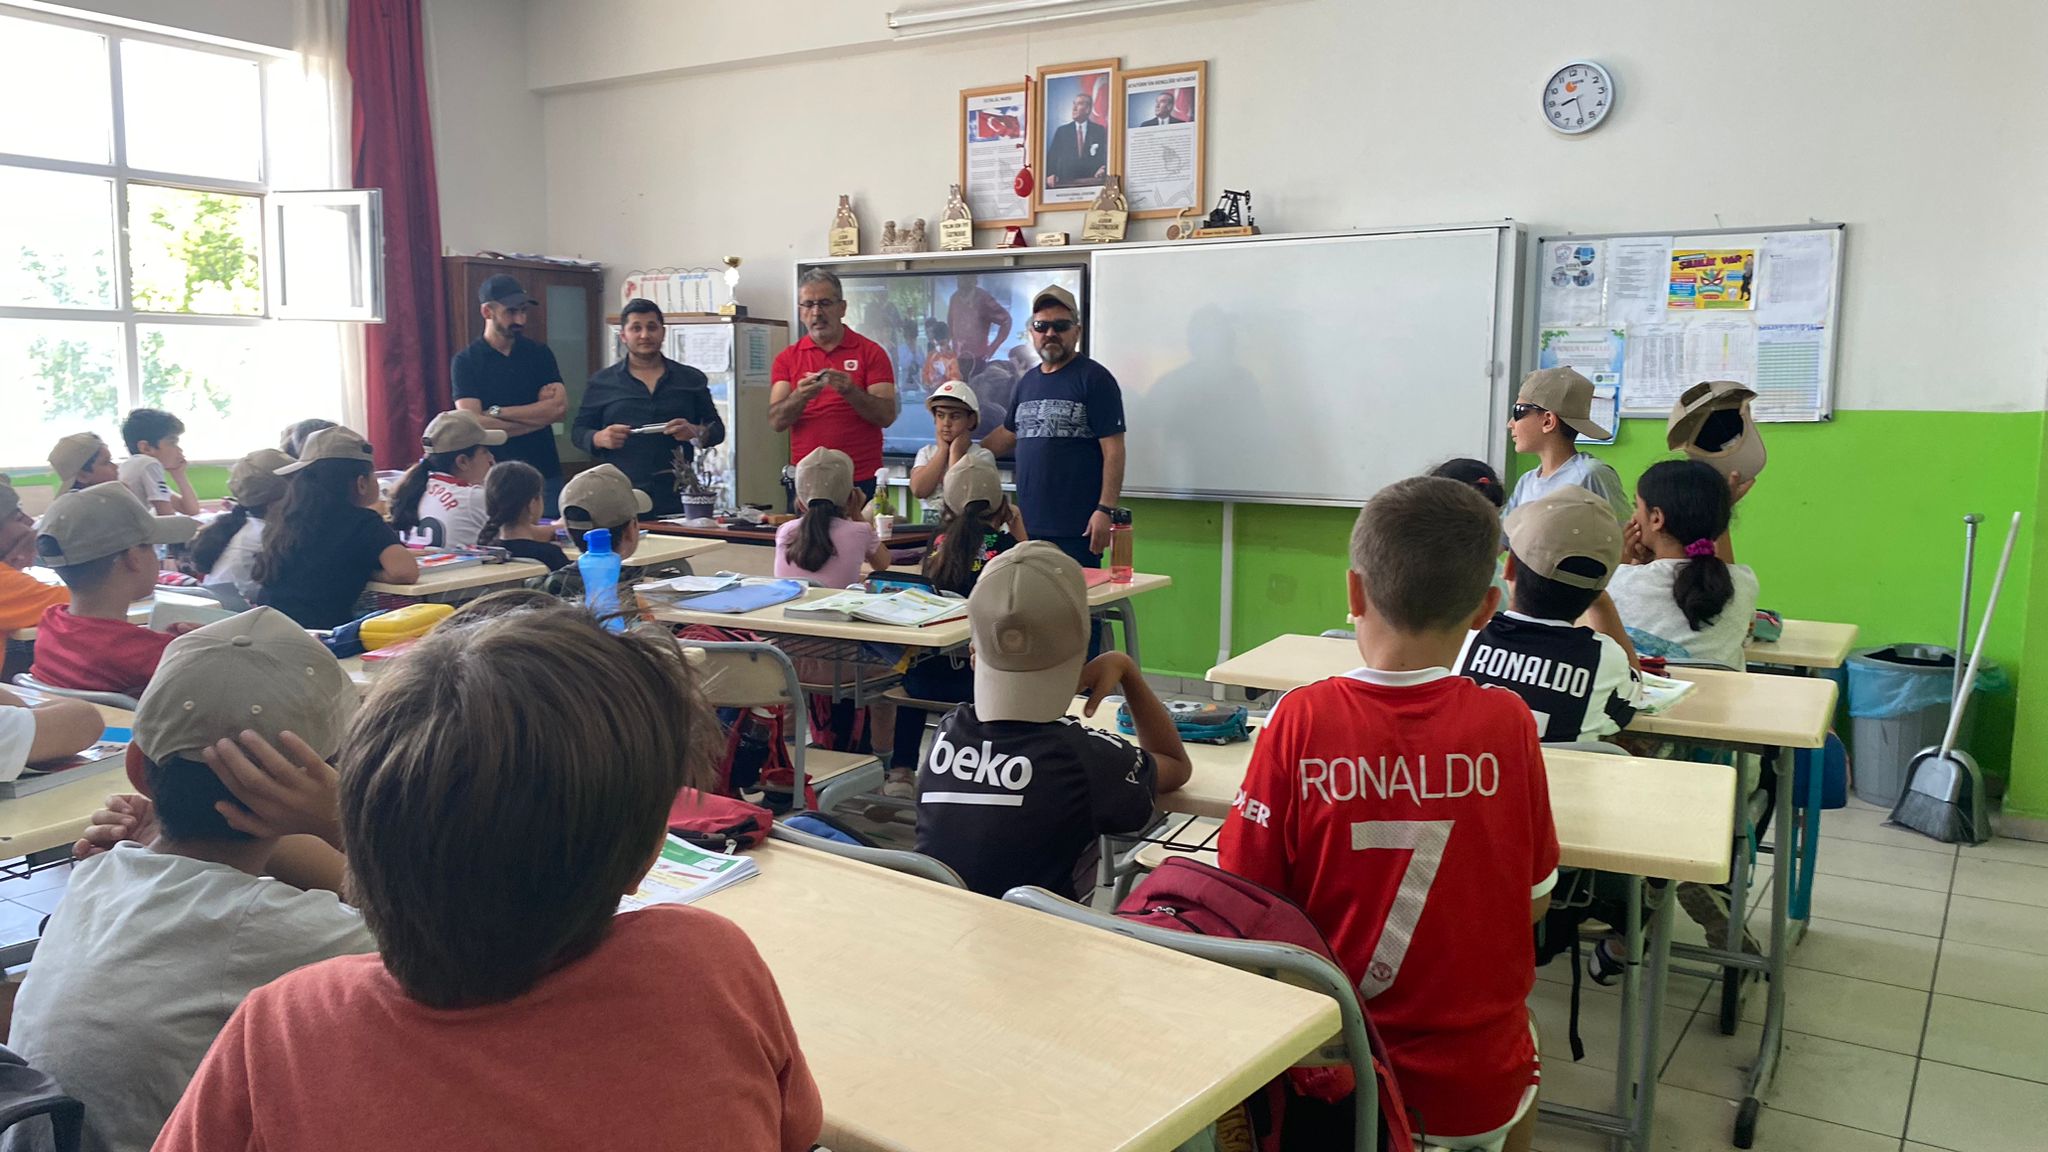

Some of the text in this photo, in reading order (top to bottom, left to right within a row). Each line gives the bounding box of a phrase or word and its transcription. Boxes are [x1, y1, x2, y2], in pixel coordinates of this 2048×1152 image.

[1592, 76, 1600, 84] 2
[1469, 644, 1590, 698] RONALDO
[928, 731, 1033, 790] beko
[1299, 752, 1499, 807] RONALDO
[1350, 820, 1456, 999] 7
